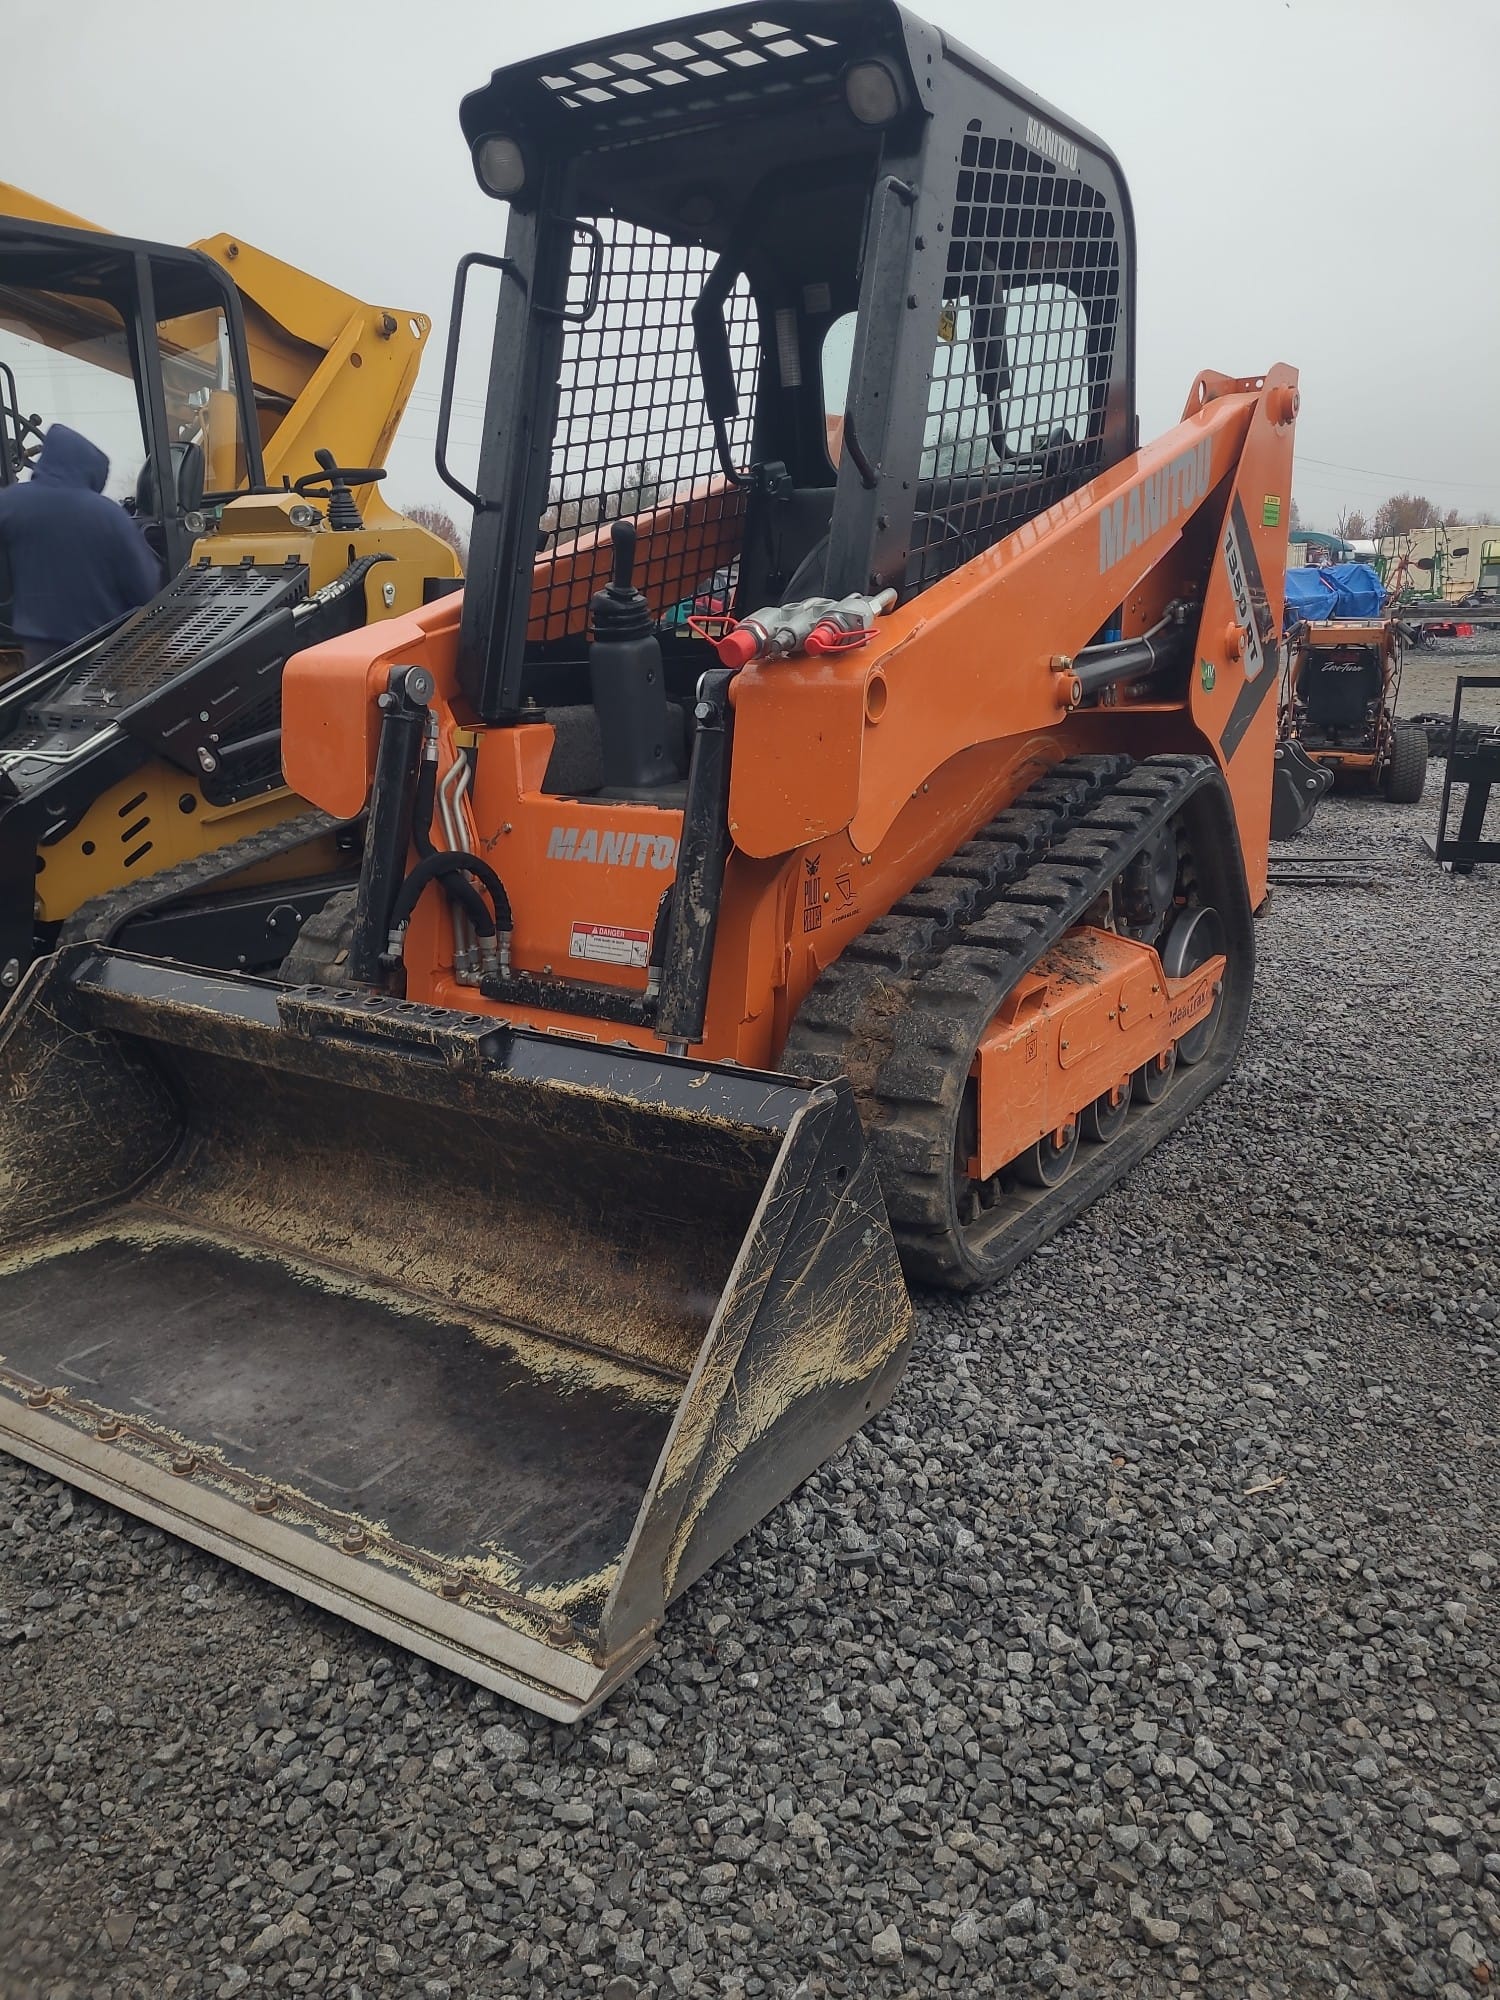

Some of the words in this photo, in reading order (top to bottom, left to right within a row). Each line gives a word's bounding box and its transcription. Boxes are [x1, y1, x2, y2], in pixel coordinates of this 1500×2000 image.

[1026, 116, 1077, 171] MANITOU
[1100, 435, 1212, 575] MANITOU
[1224, 531, 1247, 618] 1350
[546, 827, 679, 871] MANITO
[804, 877, 821, 908] PILOT
[599, 927, 625, 938] DANGER
